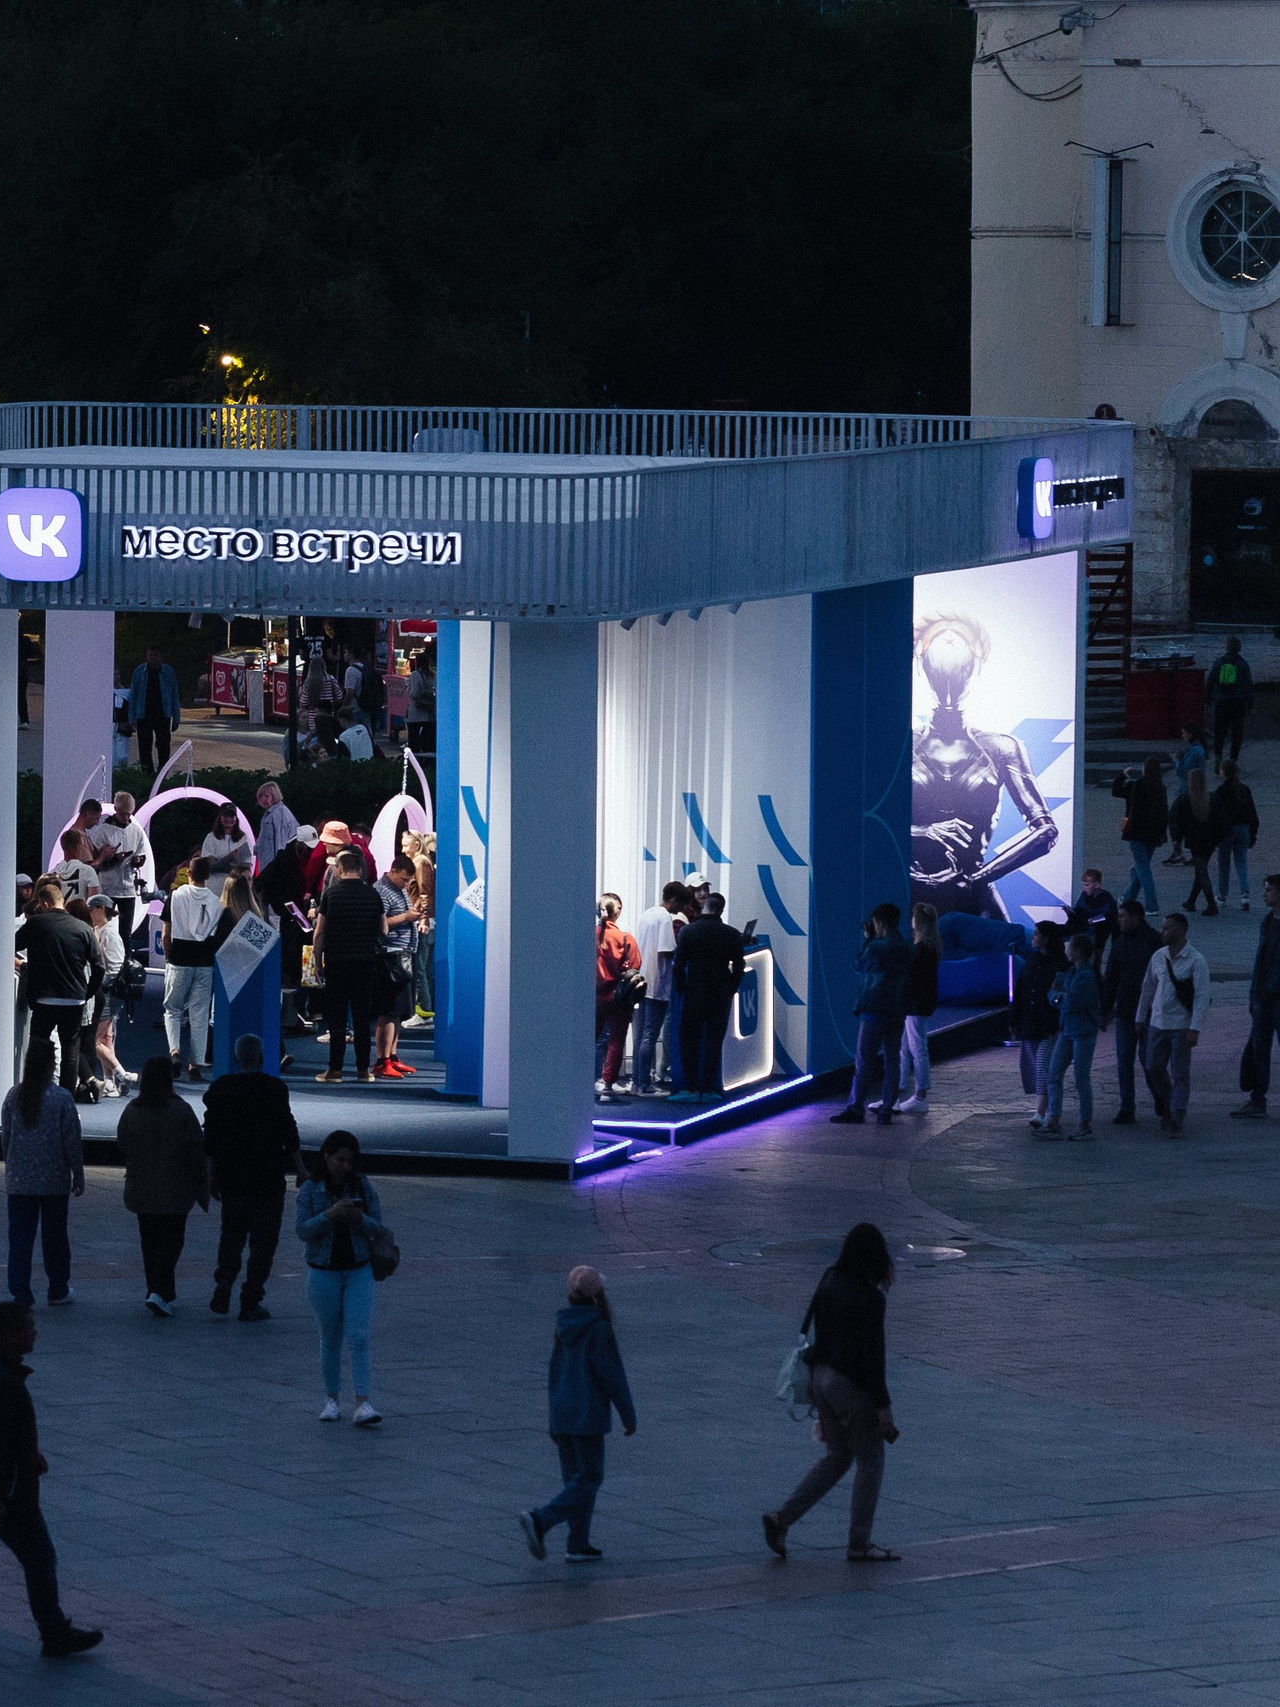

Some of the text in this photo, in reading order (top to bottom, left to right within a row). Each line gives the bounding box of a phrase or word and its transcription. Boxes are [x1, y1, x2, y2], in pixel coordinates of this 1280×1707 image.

[7, 513, 69, 558] VK
[122, 524, 463, 574] место встречи
[742, 988, 757, 1018] VK
